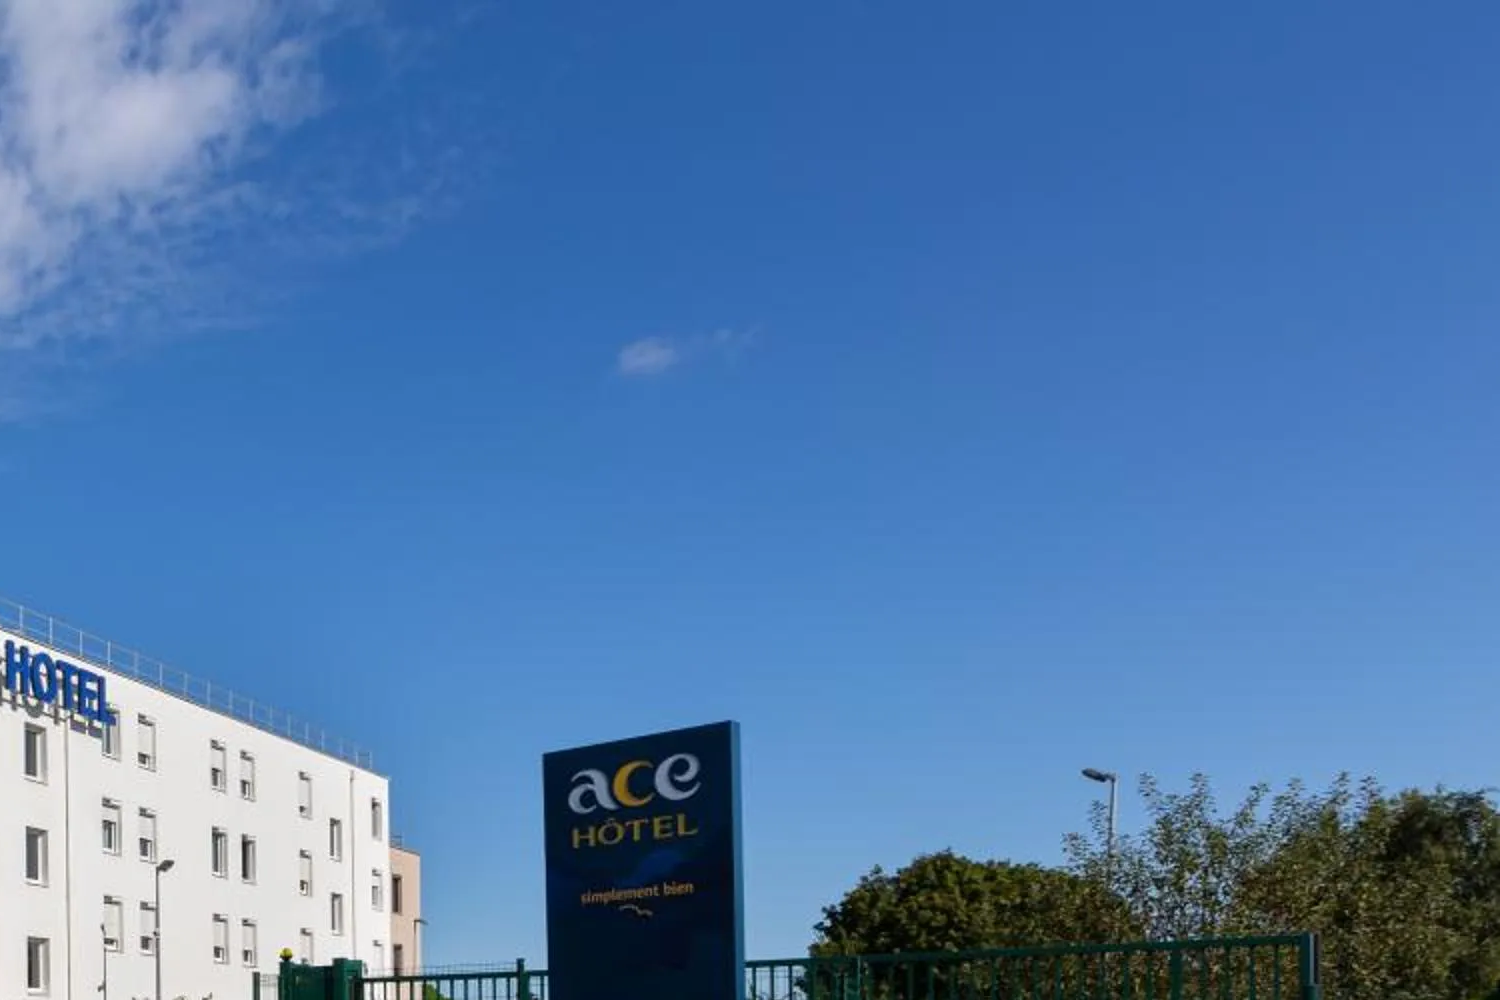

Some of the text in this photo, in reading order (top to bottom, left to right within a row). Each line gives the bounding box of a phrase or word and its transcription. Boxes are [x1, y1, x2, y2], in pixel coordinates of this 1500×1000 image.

[4, 639, 117, 726] HOTEL
[567, 752, 702, 815] ace
[571, 812, 699, 849] HÔTEL
[581, 880, 694, 905] simplement bien
